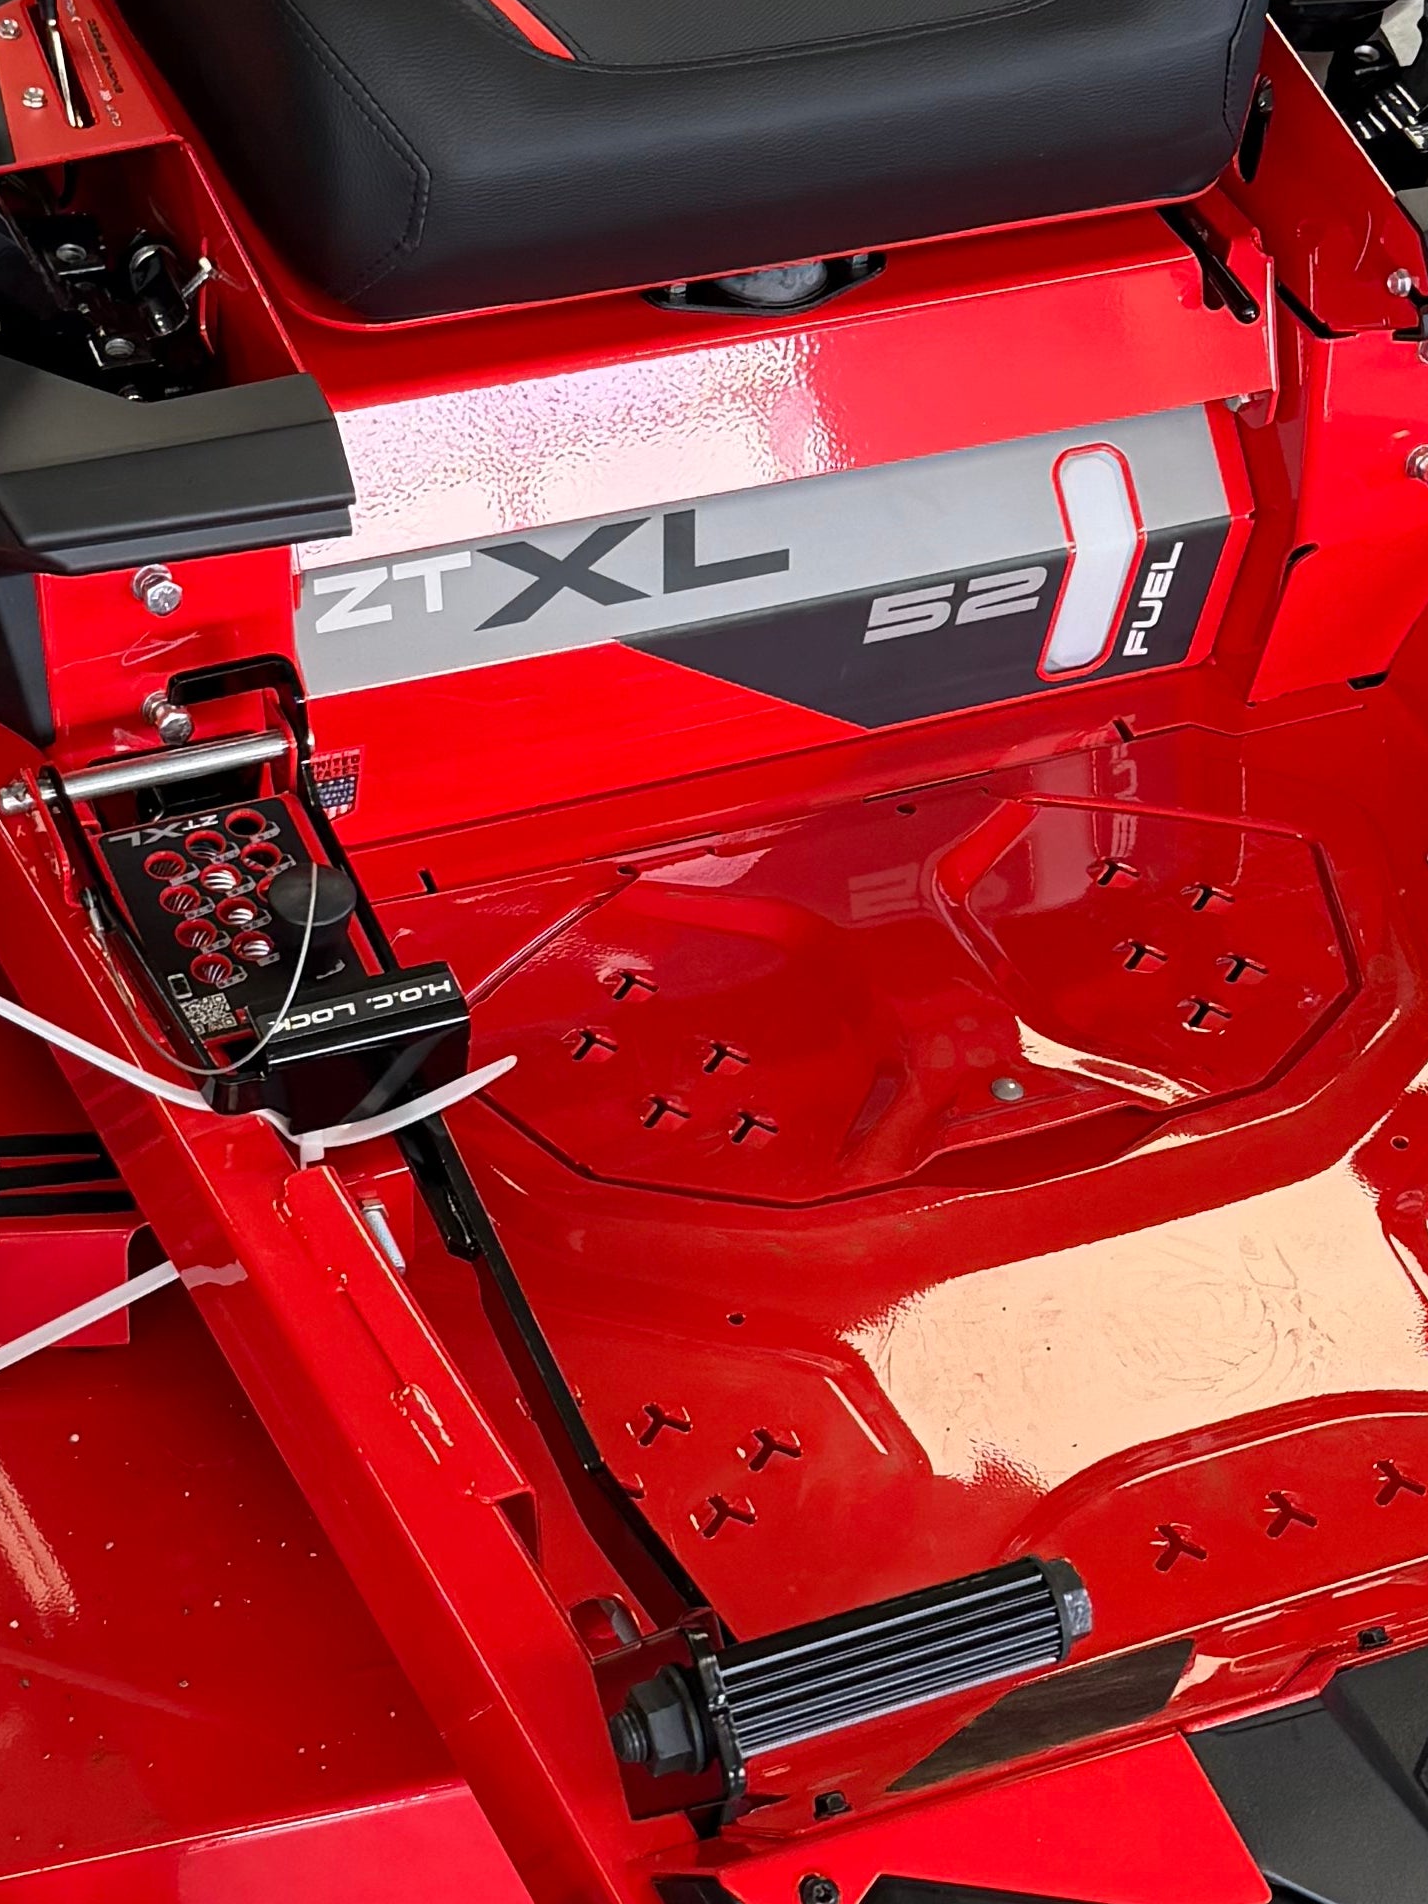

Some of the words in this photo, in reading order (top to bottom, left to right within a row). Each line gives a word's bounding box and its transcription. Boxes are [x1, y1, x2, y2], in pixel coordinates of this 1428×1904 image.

[313, 550, 472, 634] ZT
[474, 508, 790, 633] XL
[862, 566, 1048, 645] 52
[1122, 541, 1184, 656] FUEL
[107, 821, 185, 848] XL
[182, 814, 219, 832] ZT
[366, 978, 452, 1010] H.O.C.
[266, 1000, 357, 1035] LOCK
